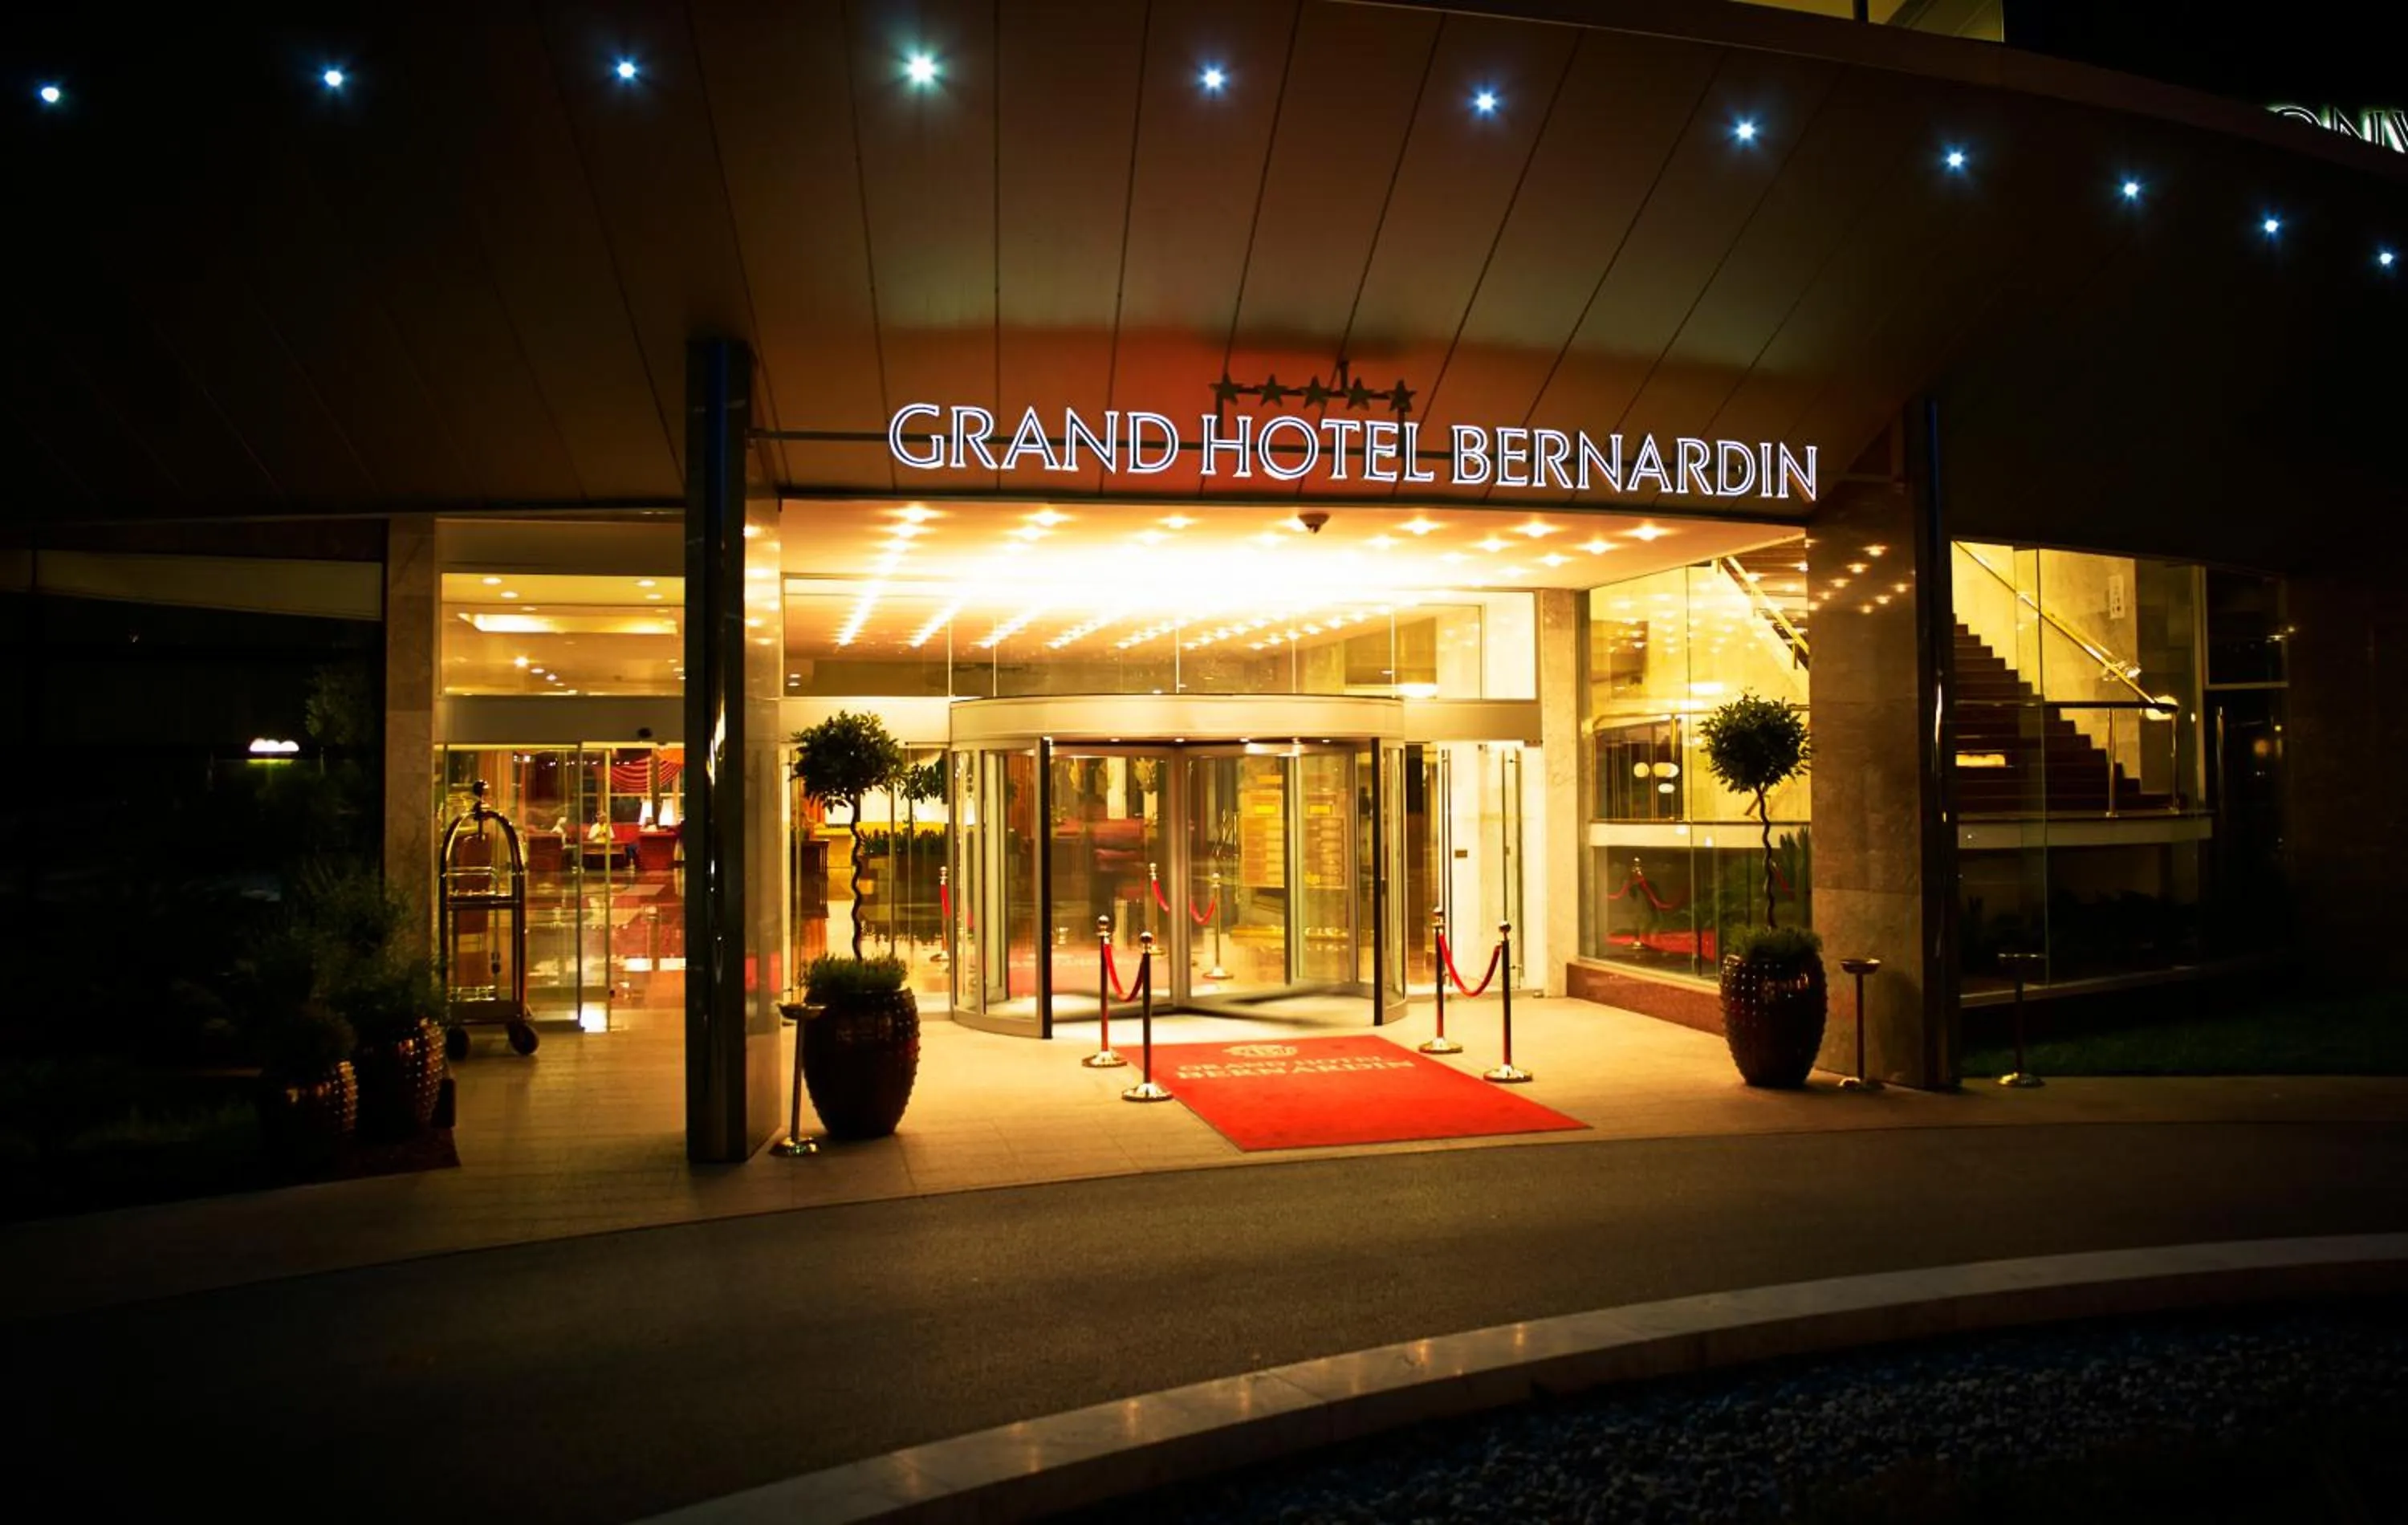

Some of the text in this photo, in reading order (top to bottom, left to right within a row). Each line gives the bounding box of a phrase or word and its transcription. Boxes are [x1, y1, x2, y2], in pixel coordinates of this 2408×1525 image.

[889, 403, 1818, 502] GRAND HOTEL BERNARDIN
[1177, 1059, 1416, 1080] BERNARDIN
